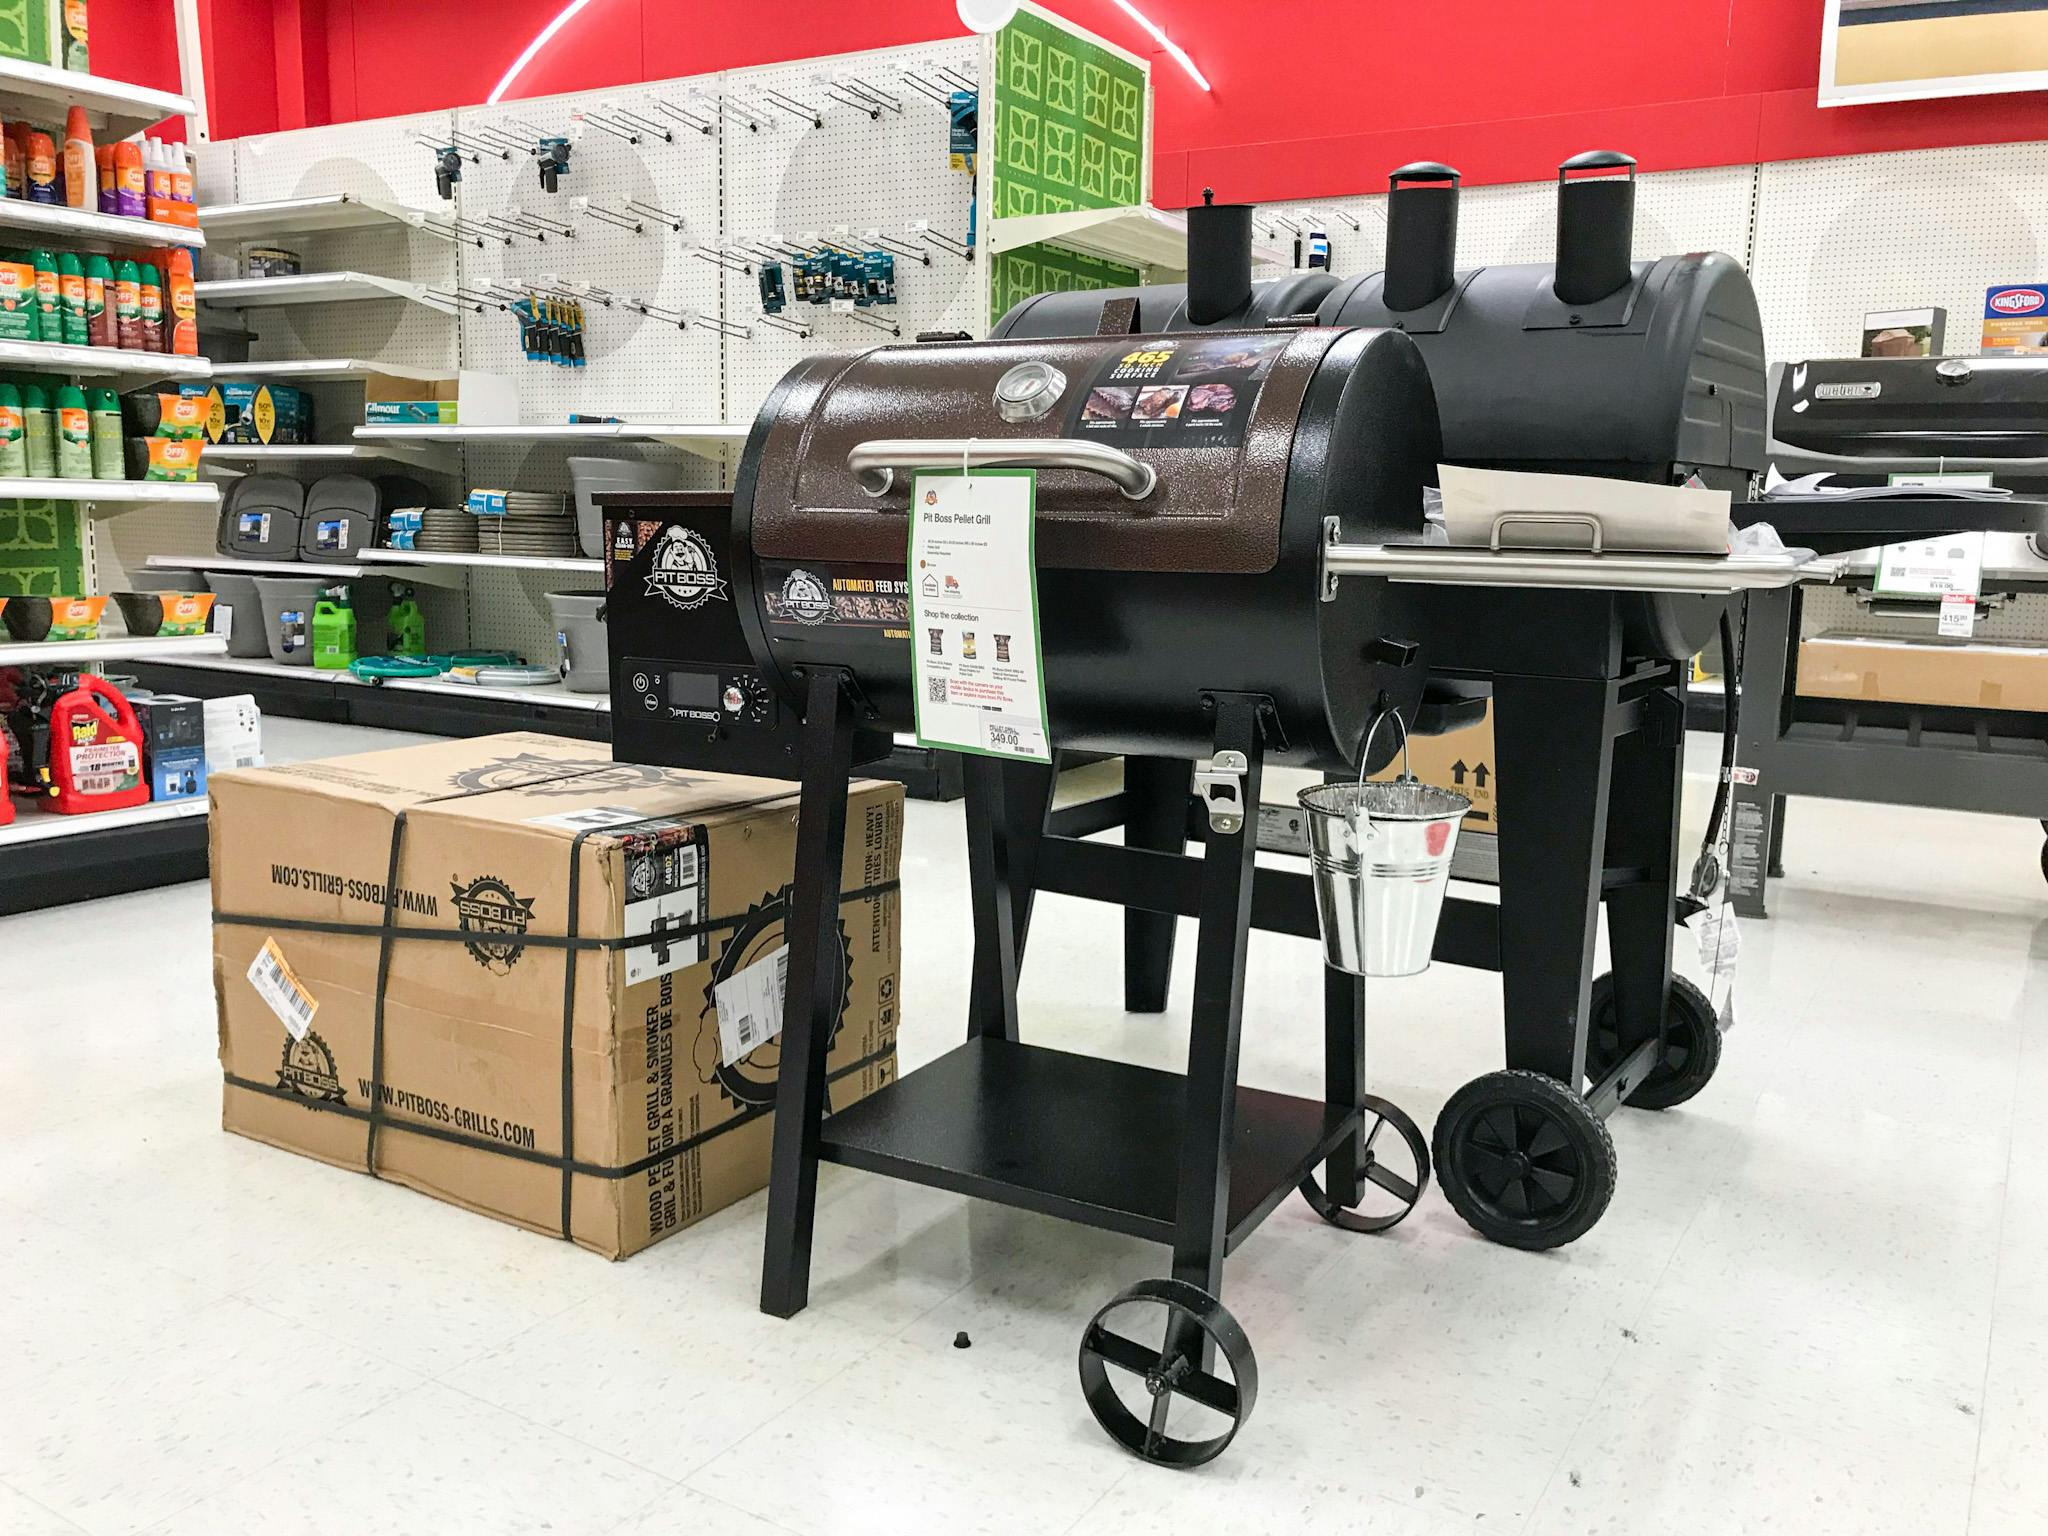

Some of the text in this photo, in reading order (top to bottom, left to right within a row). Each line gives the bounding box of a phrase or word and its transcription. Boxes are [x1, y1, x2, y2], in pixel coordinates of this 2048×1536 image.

[1994, 293, 2040, 309] KINGSFORD
[1121, 351, 1174, 364] 465
[366, 402, 401, 414] Gilmour
[923, 512, 991, 525] Pit Boss Pellet Grill
[616, 536, 634, 545] EASY
[654, 571, 716, 586] PIT BOSS
[832, 578, 875, 593] AUTOMATED
[875, 580, 893, 593] FEED
[785, 600, 830, 611] PIT BOSS
[924, 610, 979, 622] Shop the collection
[675, 709, 714, 719] PIT BOSS
[72, 721, 98, 741] Raid
[990, 732, 1019, 746] 349.00
[76, 750, 126, 760] PROTECTION
[90, 763, 101, 771] 18
[1473, 788, 1489, 800] END
[874, 813, 883, 850] LOURD
[864, 806, 875, 904] CUTION: HEAVY!
[271, 864, 438, 917] WWW.PTBOSS-GRILLS.COM
[460, 900, 526, 925] PIT BOSS
[659, 972, 673, 1006] BOIS
[660, 1009, 673, 1030] DE
[646, 1004, 660, 1068] SMOKER
[646, 1070, 660, 1084] &
[660, 1033, 674, 1106] GRANULES
[283, 1066, 338, 1091] PIT BOSS
[358, 1077, 536, 1150] WW.PITBOSS-GRILLS.COM
[646, 1087, 660, 1130] GRILL
[661, 1121, 675, 1178] FUOIR
[663, 1179, 676, 1193] &
[648, 1190, 663, 1237] WOOD
[663, 1194, 677, 1229] GRIL
